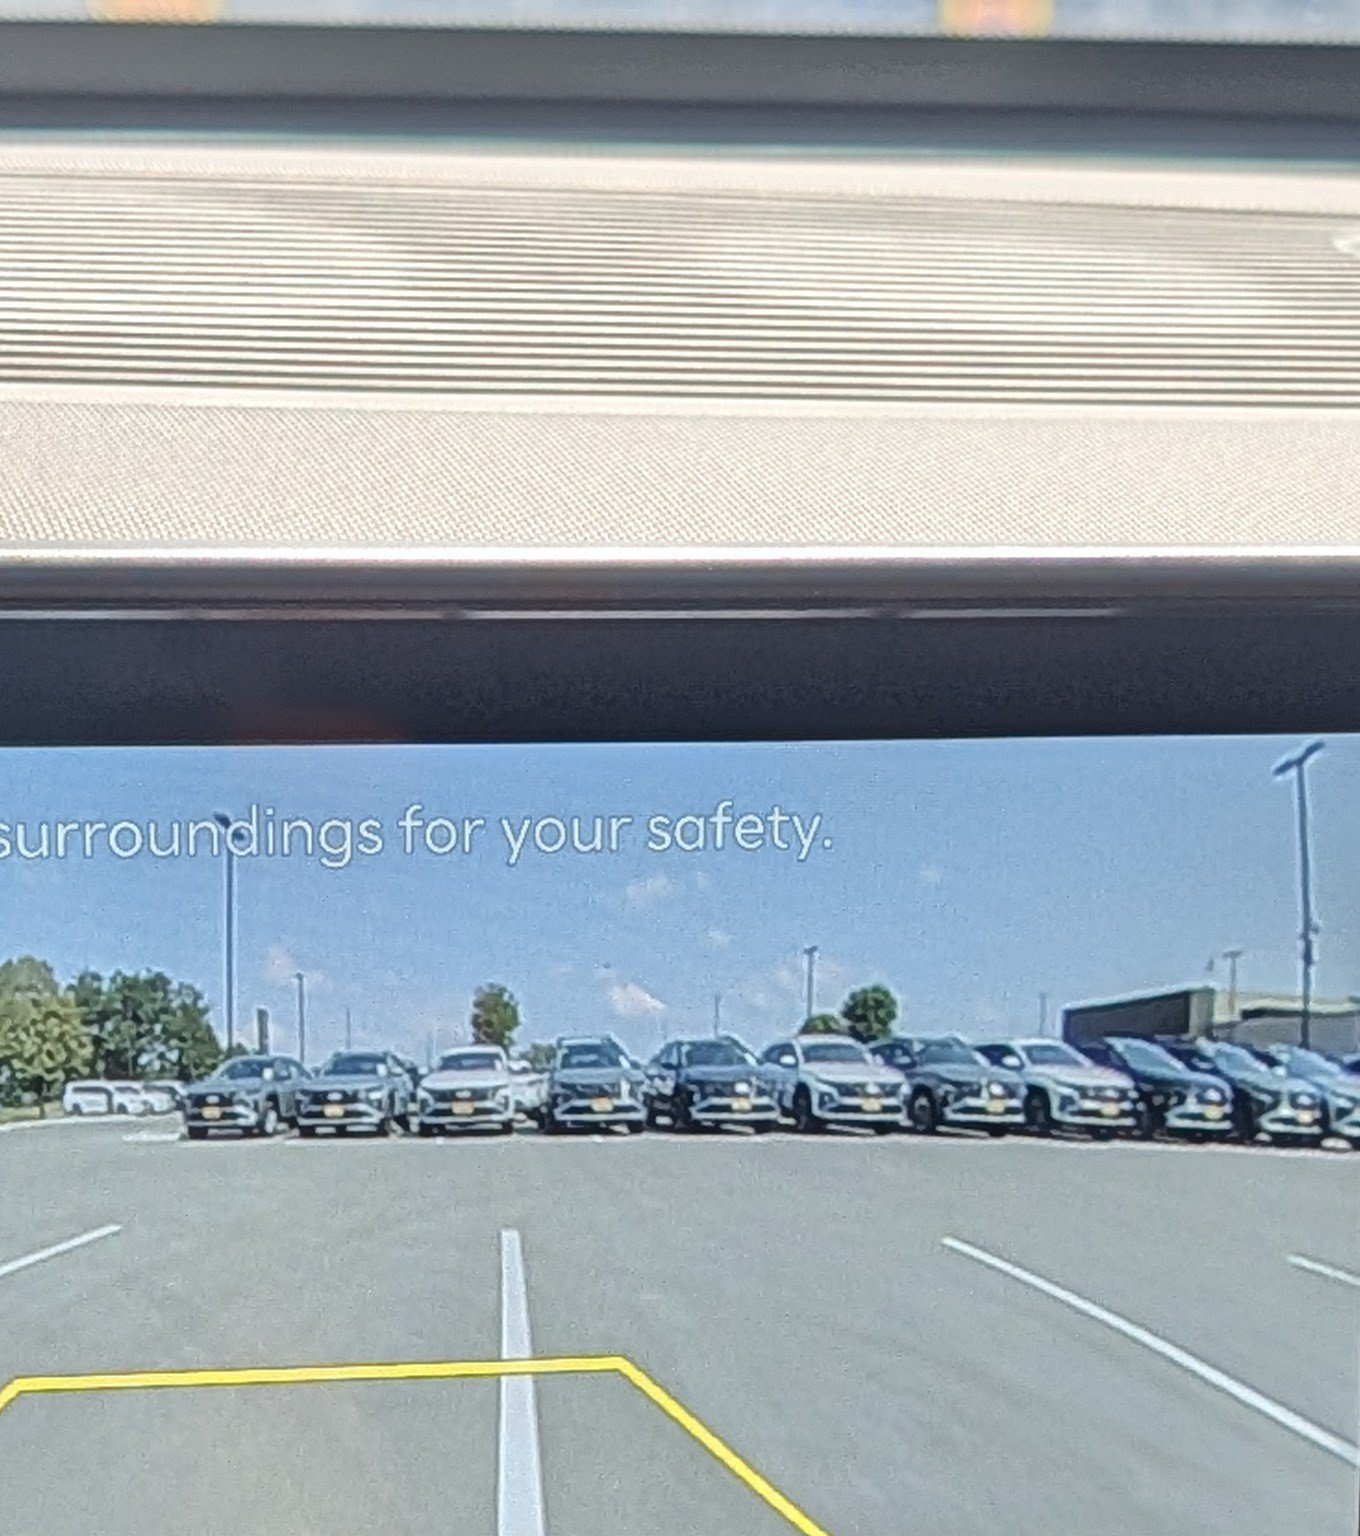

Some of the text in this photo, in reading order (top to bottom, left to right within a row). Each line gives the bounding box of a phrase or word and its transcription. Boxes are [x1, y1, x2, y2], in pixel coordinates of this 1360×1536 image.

[398, 803, 485, 858] for
[501, 811, 634, 865] your
[645, 801, 834, 863] safety.
